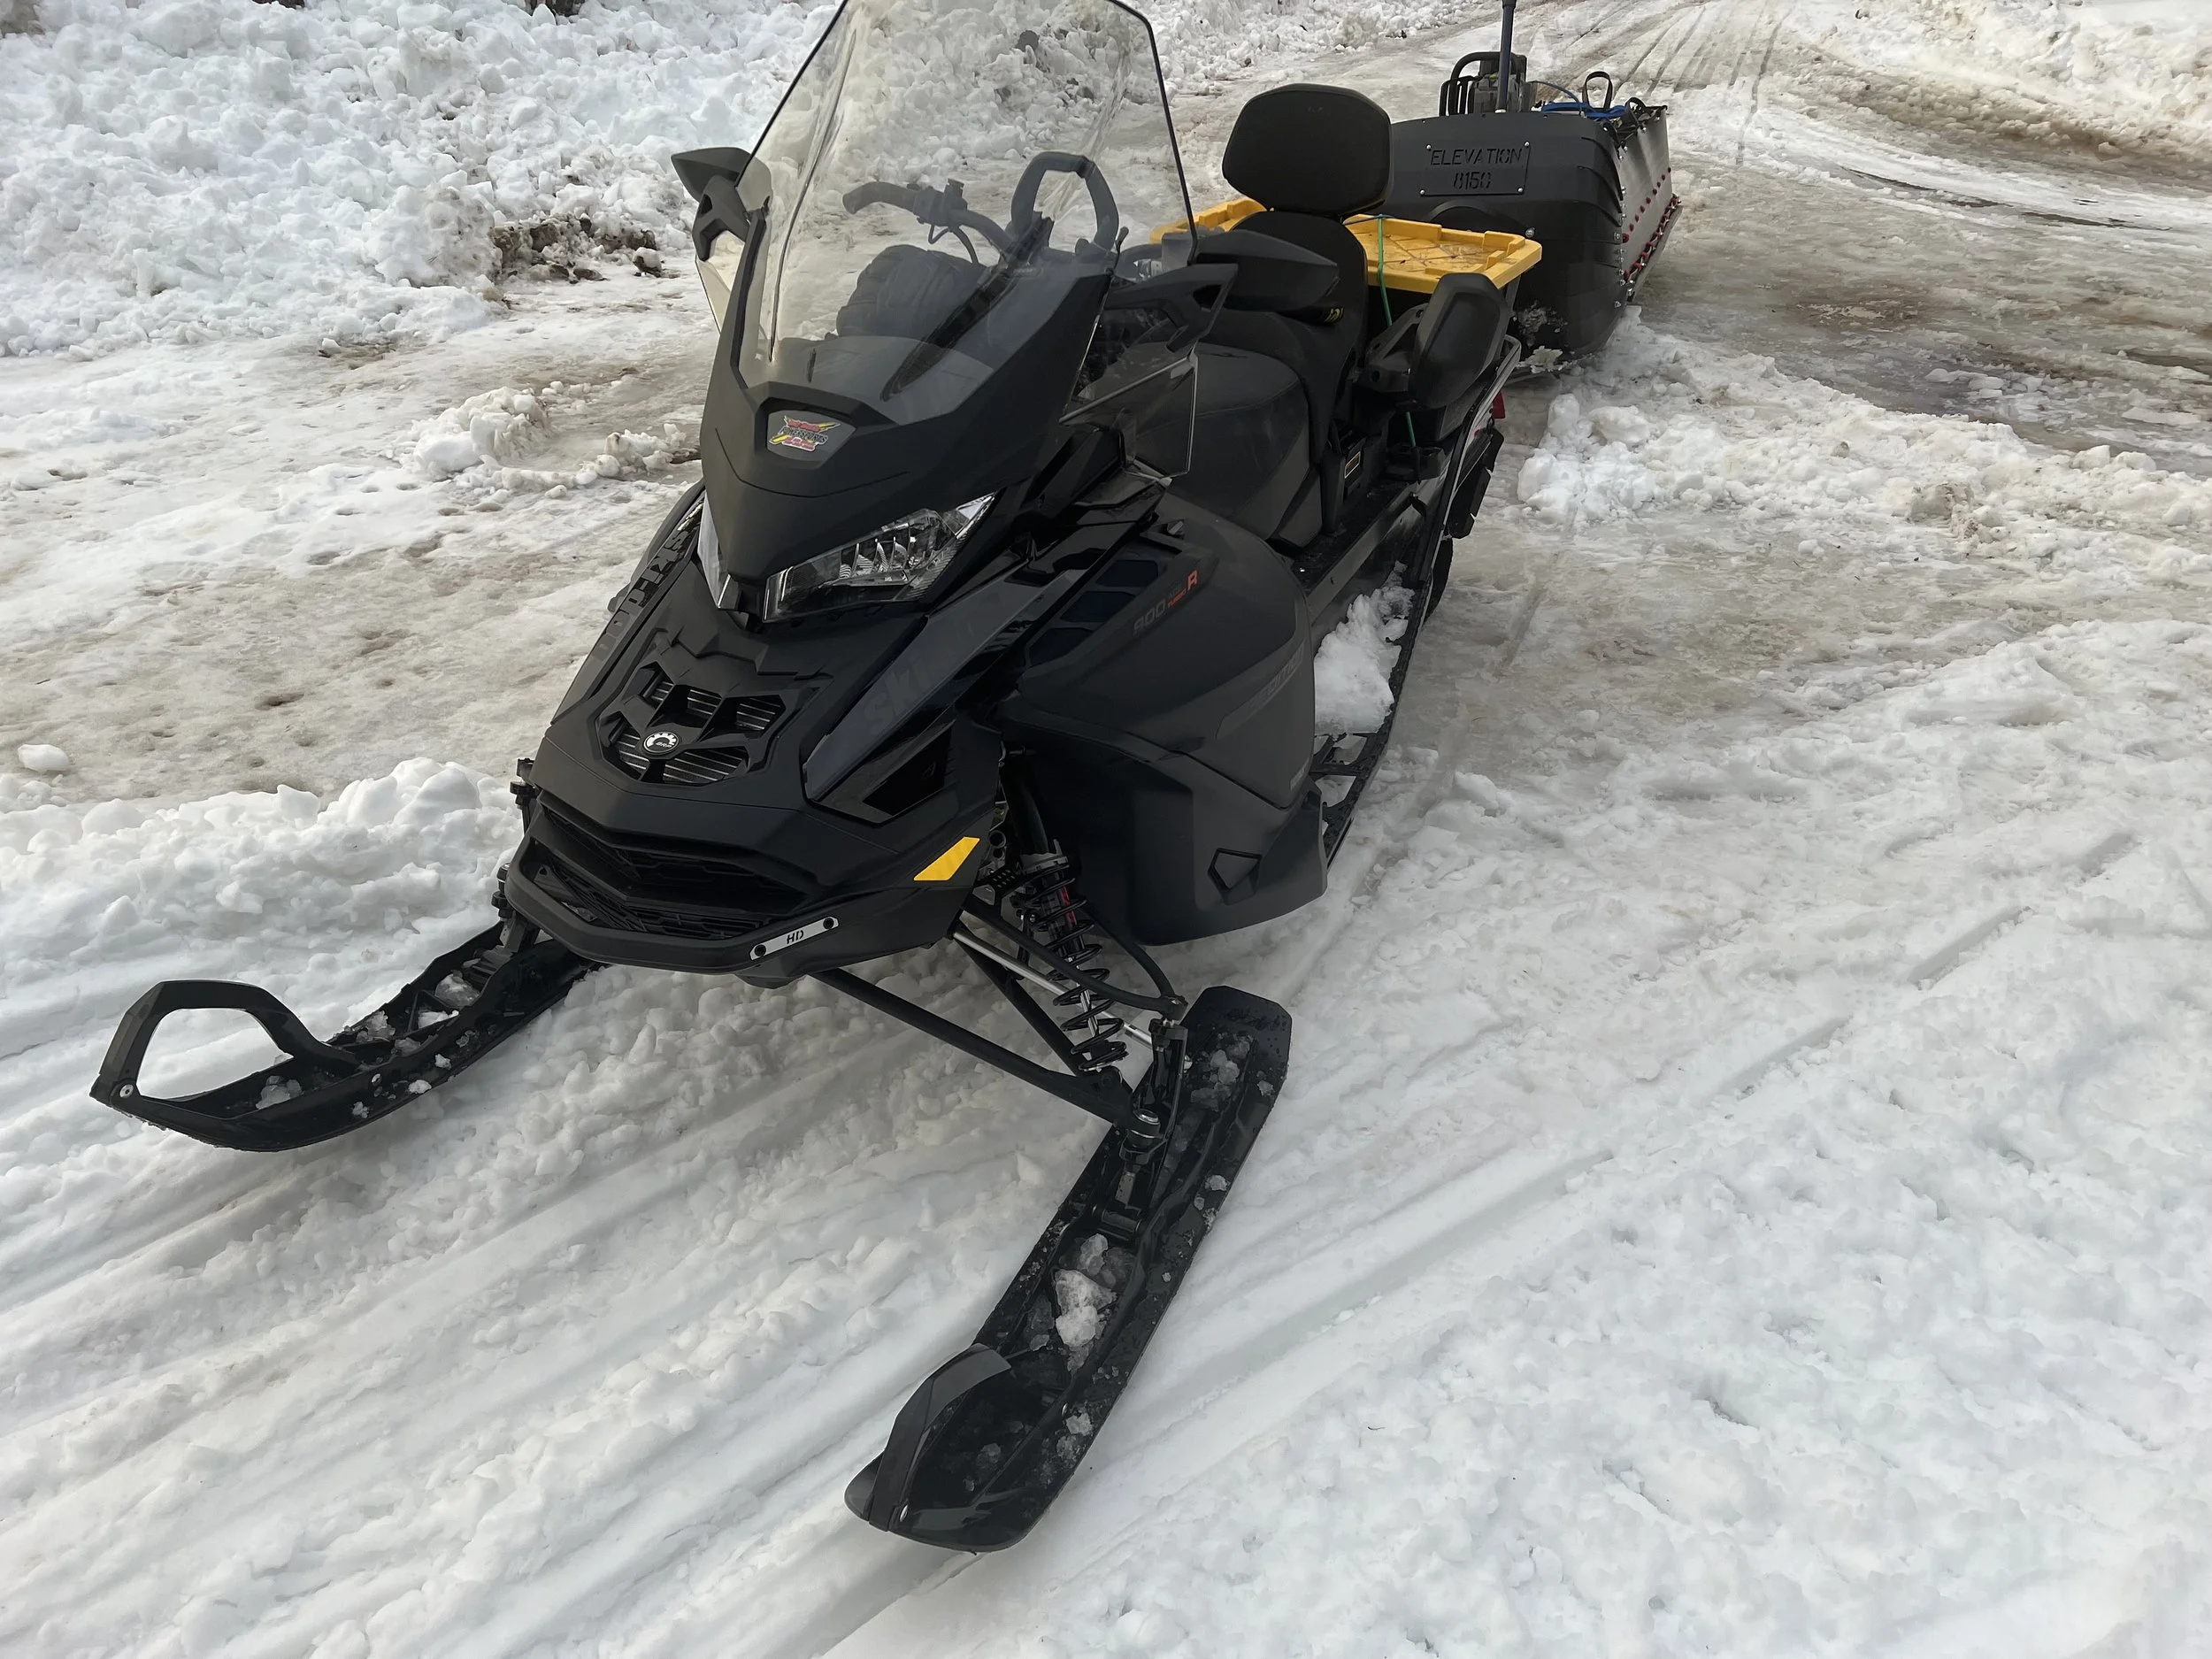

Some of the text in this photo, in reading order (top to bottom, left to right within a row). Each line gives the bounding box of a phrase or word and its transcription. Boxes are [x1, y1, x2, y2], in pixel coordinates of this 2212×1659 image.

[1430, 147, 1523, 166] ELEVATION
[1133, 598, 1166, 638] 900
[1187, 569, 1199, 591] R
[786, 929, 804, 944] HD
